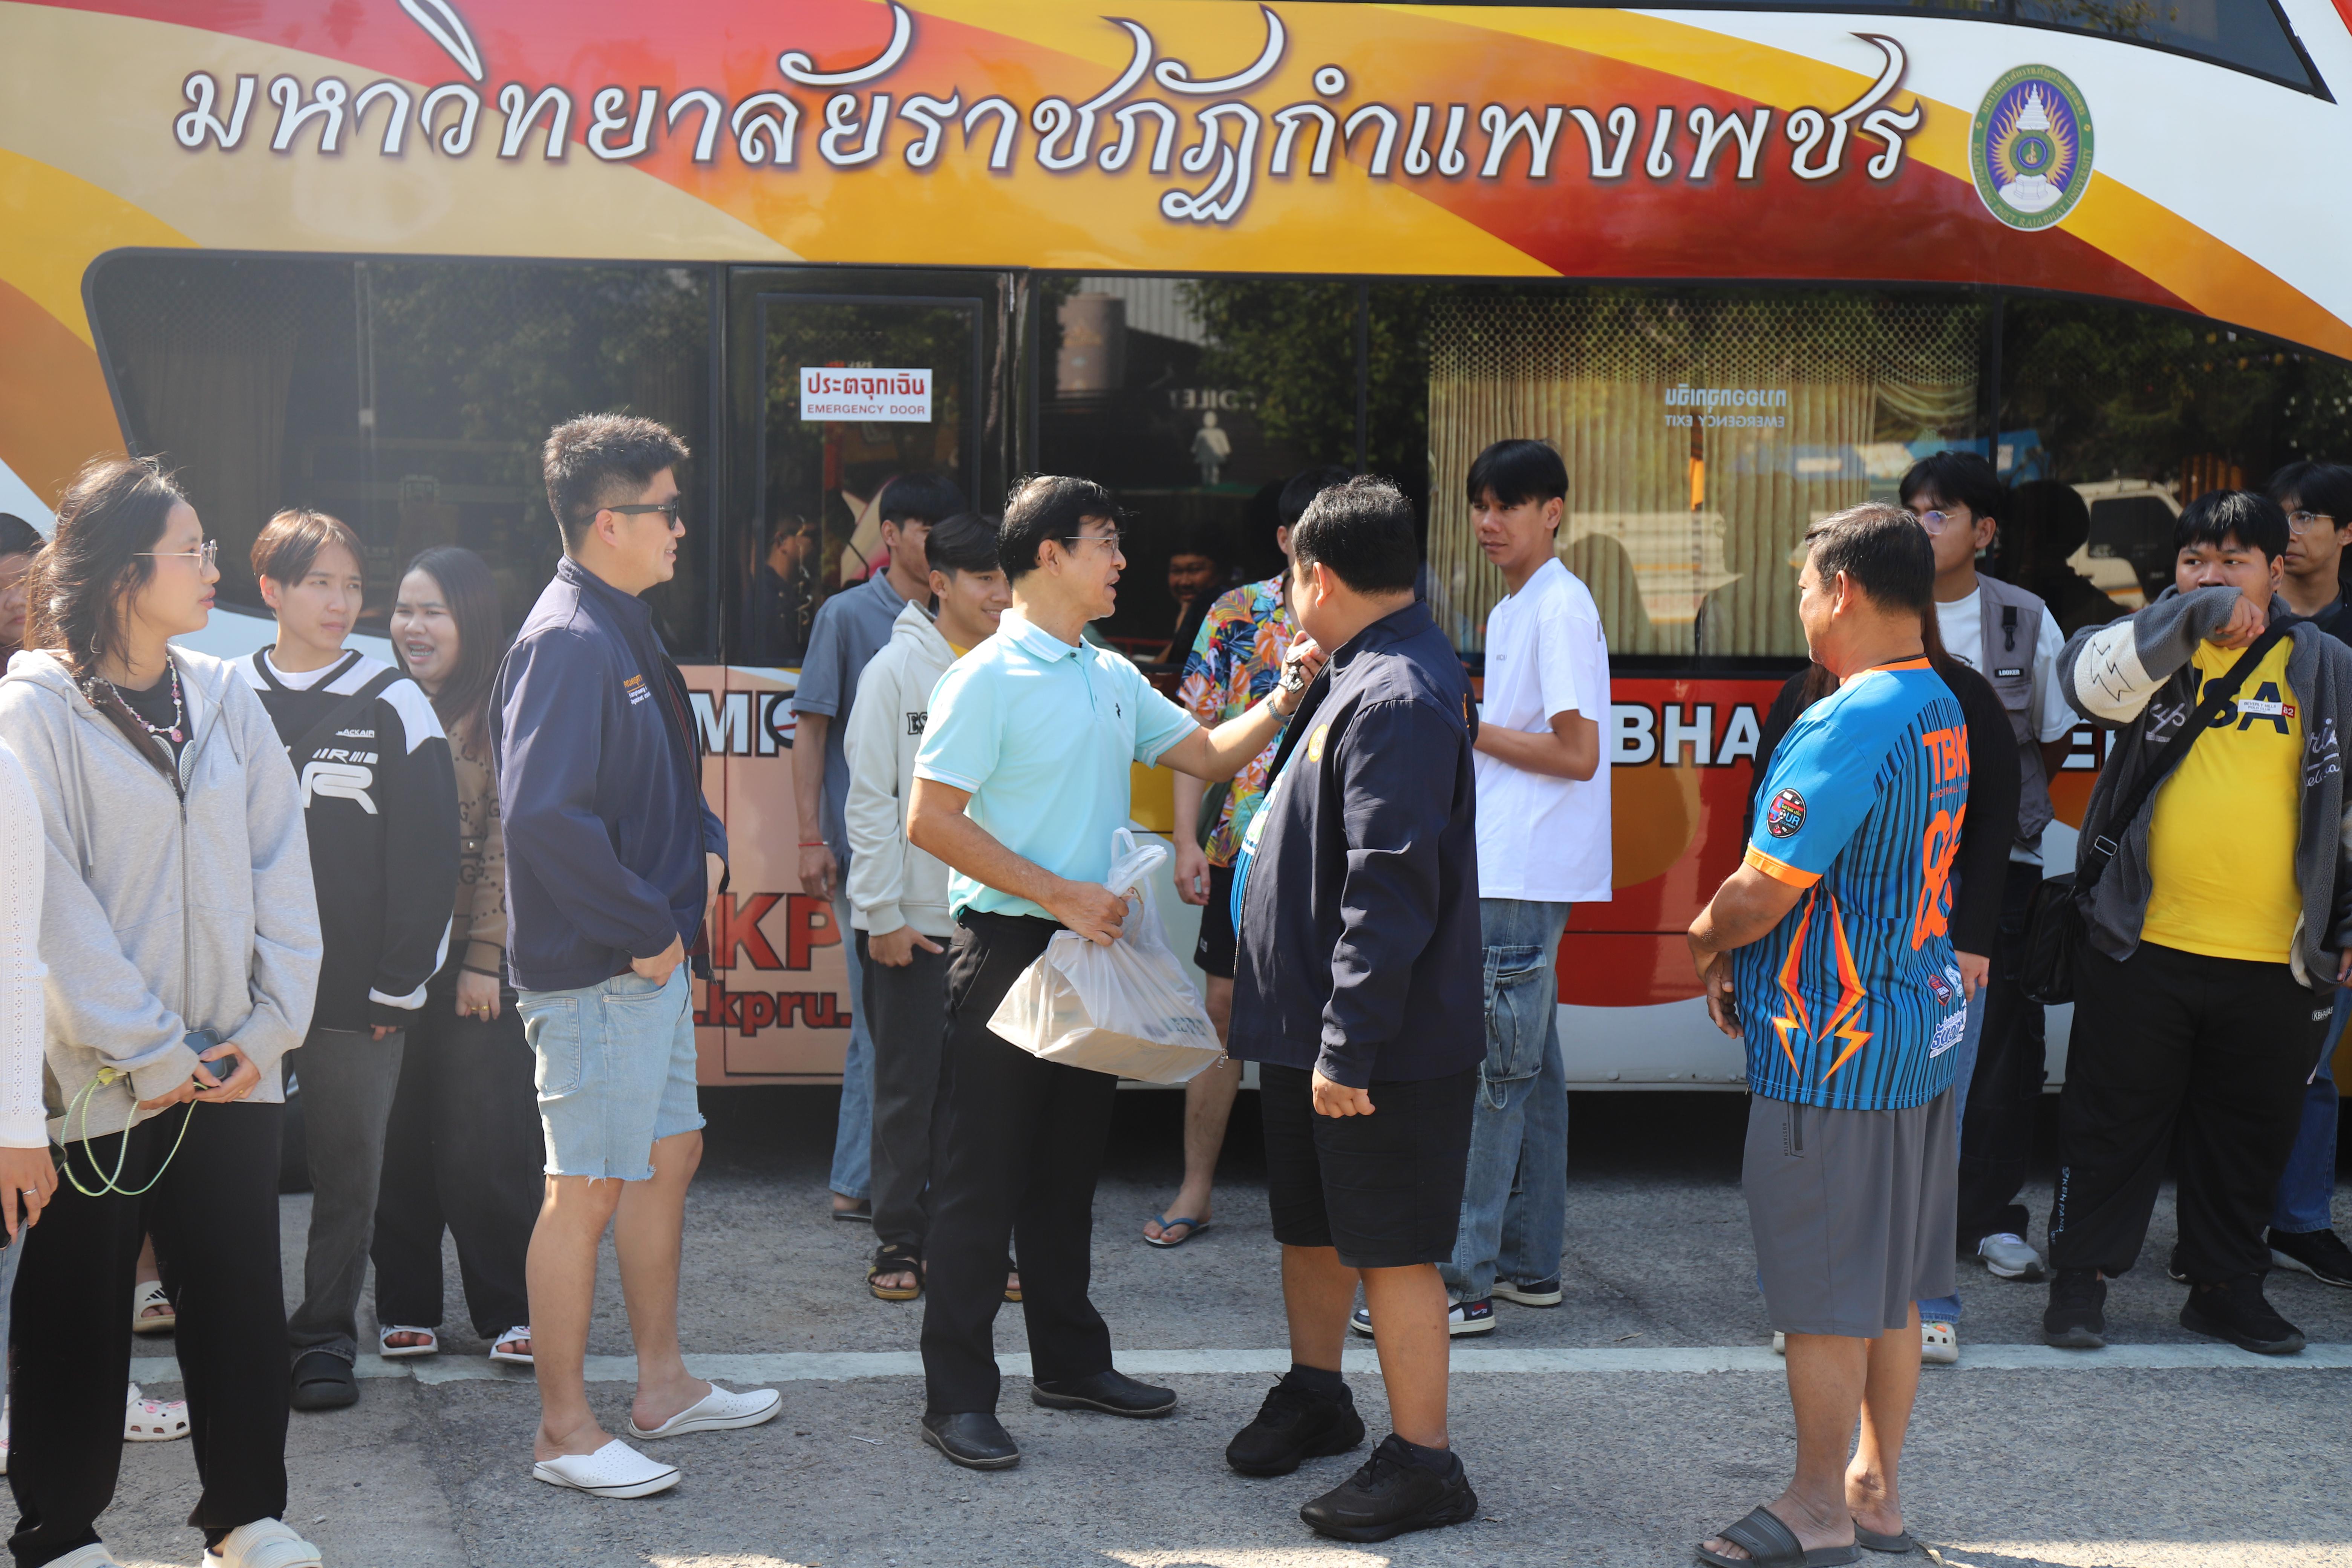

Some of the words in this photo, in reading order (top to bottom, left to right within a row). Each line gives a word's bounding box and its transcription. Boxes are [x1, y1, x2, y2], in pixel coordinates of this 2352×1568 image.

[174, 0, 1923, 222] มหาวิทยาลัยราชภัฏกำแพงเพชร
[1993, 202, 2016, 224] PHET
[2066, 147, 2093, 205] UNIVERSITY
[807, 404, 885, 414] EMERGENCY
[890, 405, 925, 415] DOOR
[2283, 706, 2294, 716] 82
[1922, 724, 1970, 784] TBK
